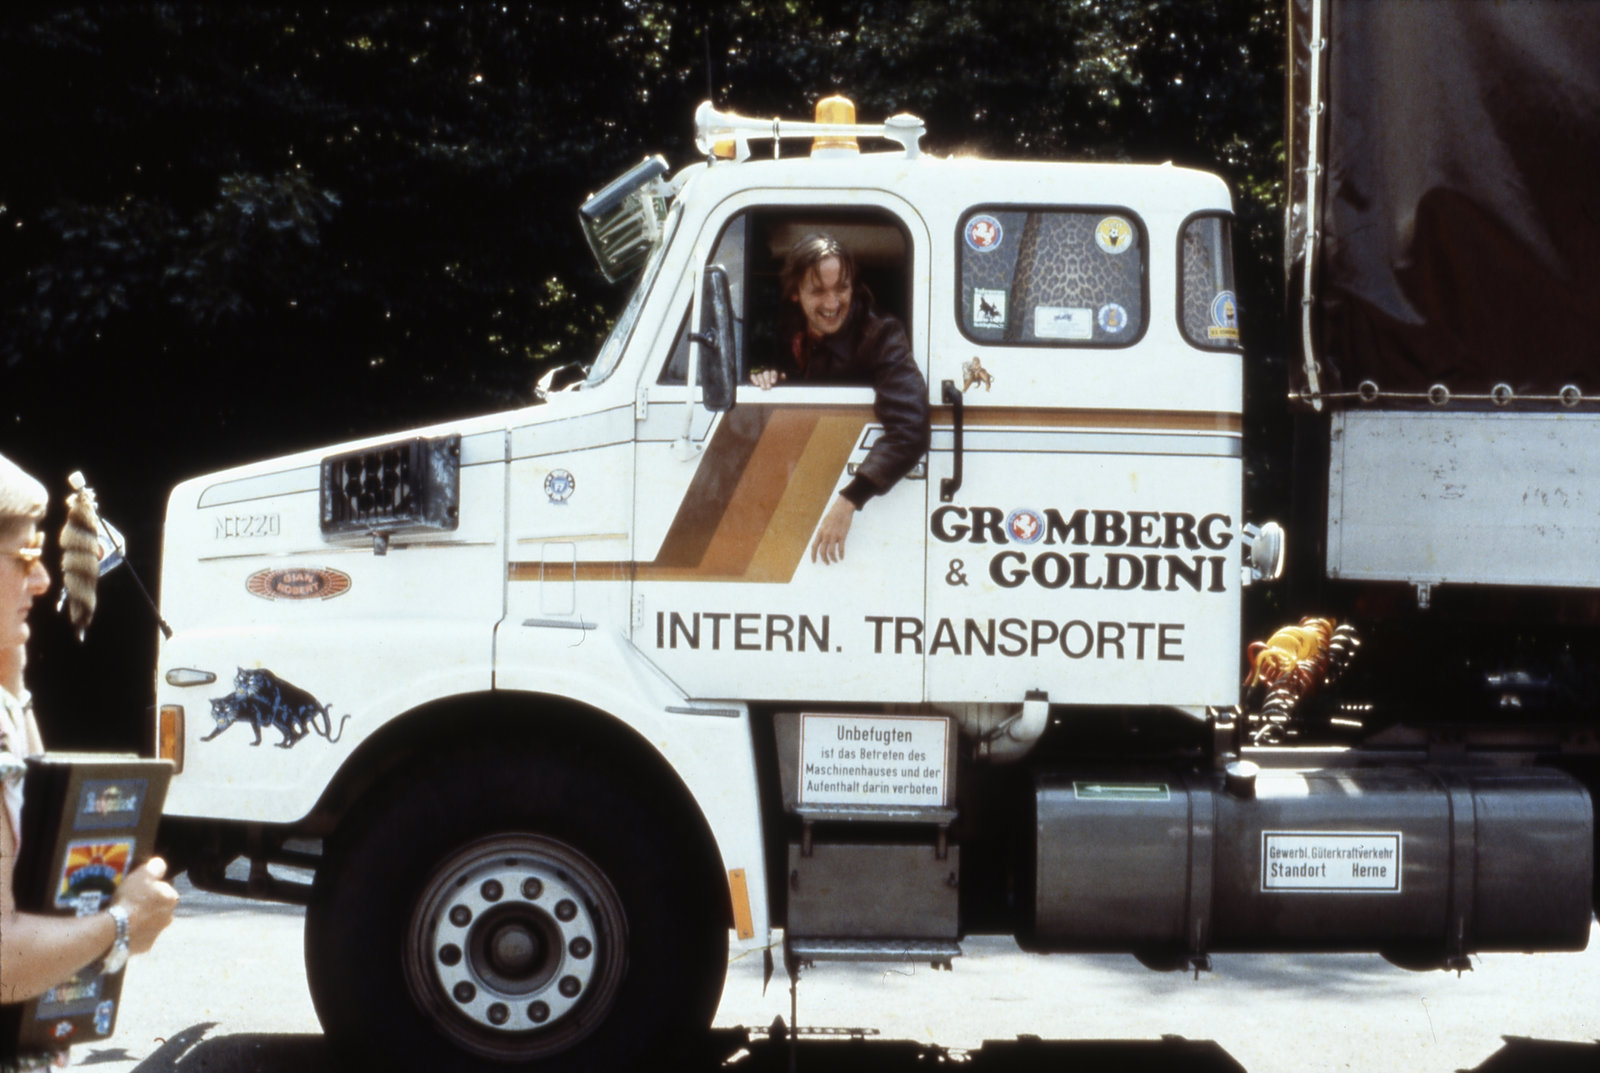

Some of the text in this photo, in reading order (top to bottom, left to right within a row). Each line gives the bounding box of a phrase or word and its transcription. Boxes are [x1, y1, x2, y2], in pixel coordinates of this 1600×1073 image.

[945, 551, 1227, 593] & GOLDINI
[656, 611, 1185, 661] INTERN. TRANSPORTE
[837, 725, 913, 746] Unbefugten
[821, 747, 927, 762] ist das Betreten des
[805, 763, 941, 779] Maschinenhauses und der
[806, 780, 938, 796] Aufenthalt darin verboten
[1270, 862, 1388, 878] Standort Herne
